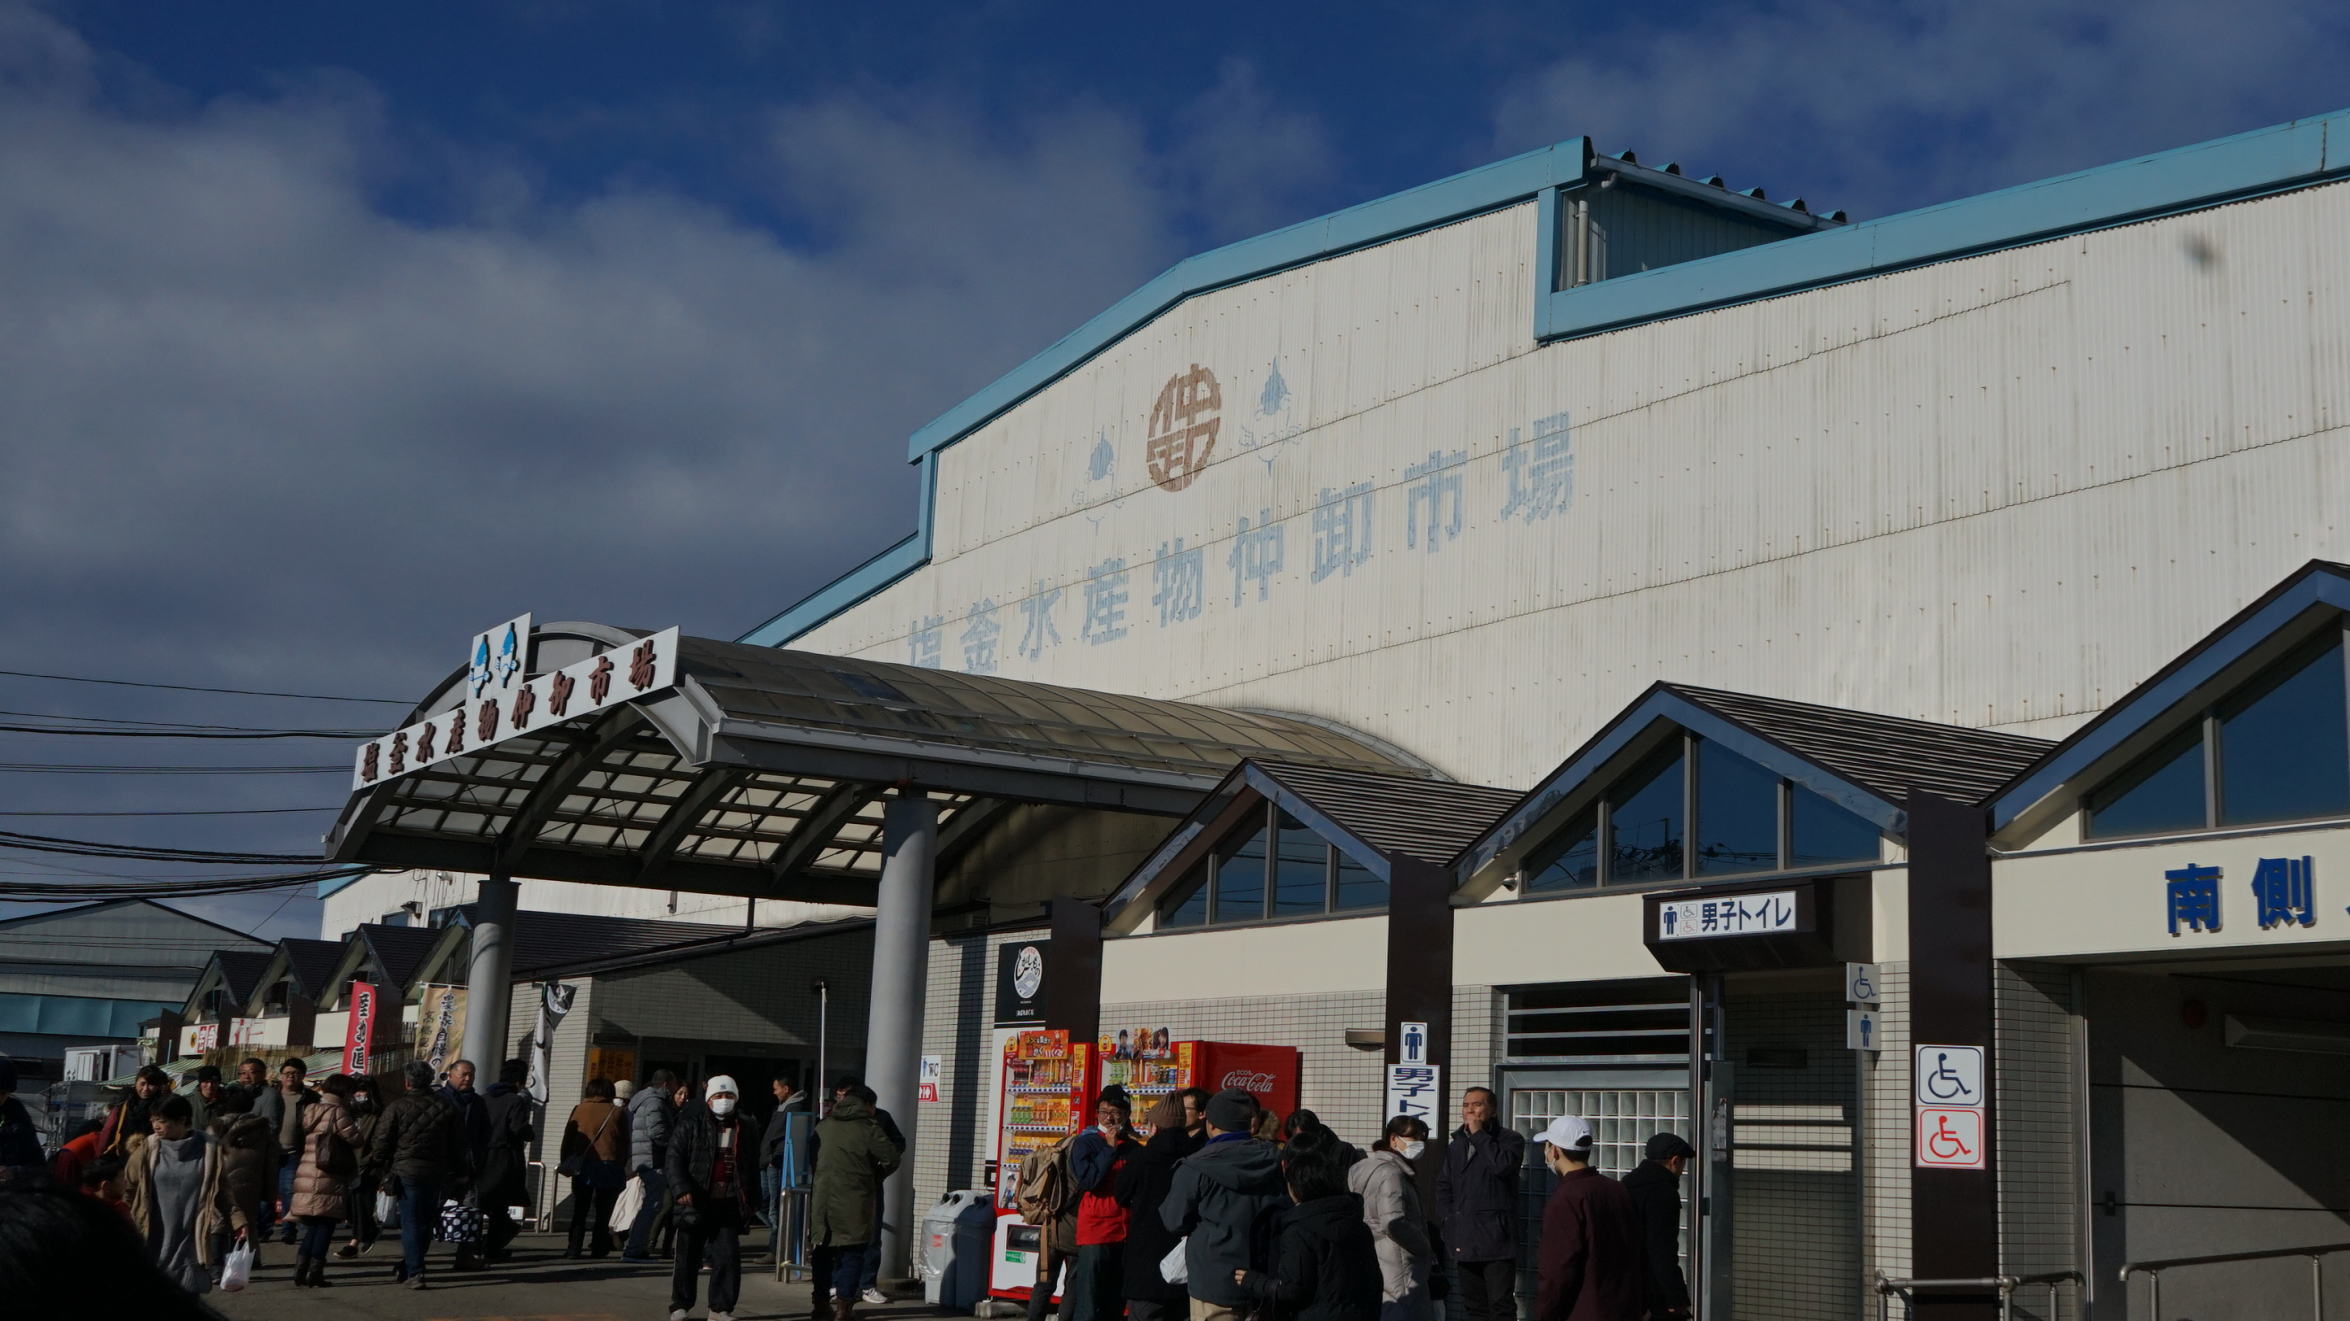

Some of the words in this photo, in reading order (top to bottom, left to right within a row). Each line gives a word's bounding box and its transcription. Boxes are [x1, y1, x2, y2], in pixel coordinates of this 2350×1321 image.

[908, 411, 1574, 674] 塩釜水産物仲卸市場
[1702, 898, 1791, 932] 男子トイレ
[2164, 855, 2350, 937] 南側
[1221, 1071, 1276, 1093] Coca-Cola
